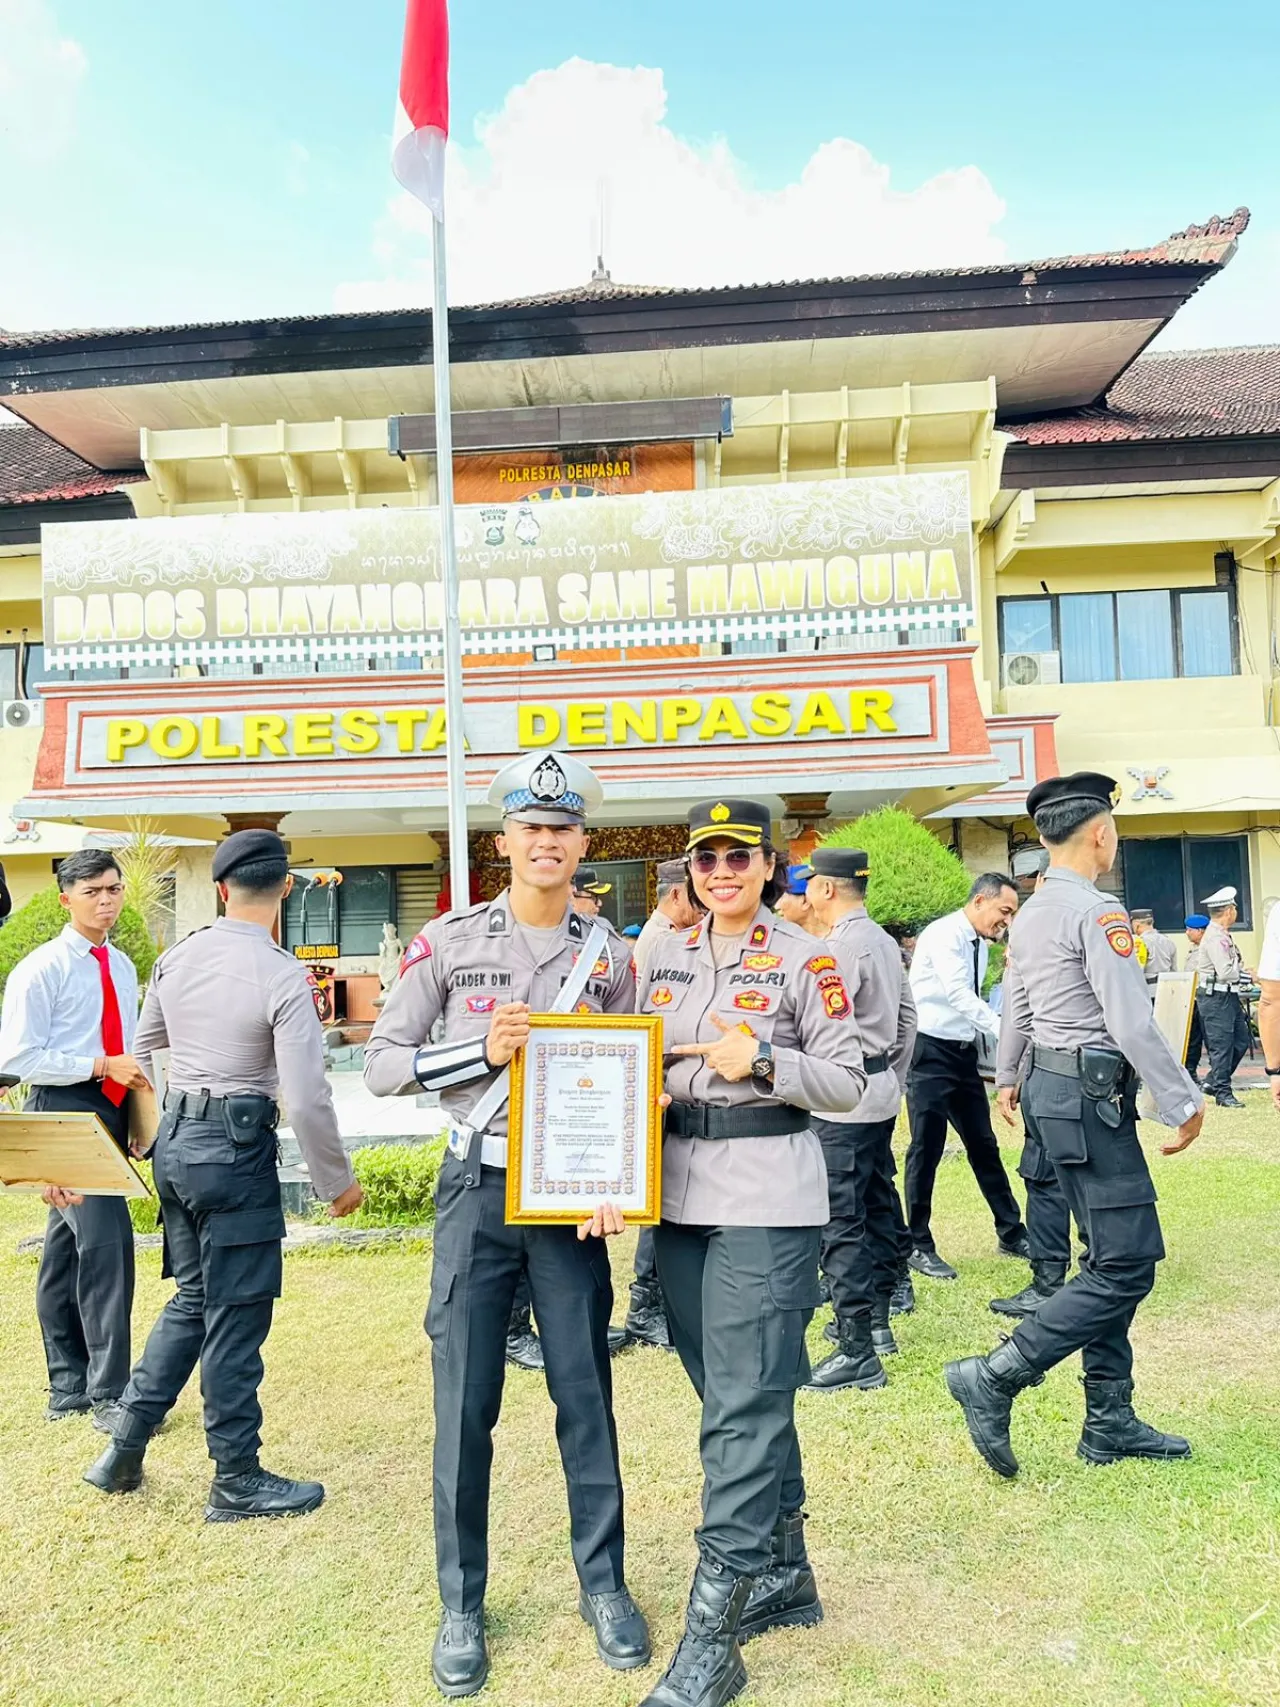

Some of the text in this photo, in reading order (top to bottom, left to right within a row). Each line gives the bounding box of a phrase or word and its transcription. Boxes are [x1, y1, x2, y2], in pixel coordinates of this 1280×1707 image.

[500, 461, 631, 483] POLRESTA DENPASAR
[54, 589, 206, 644] DADOS
[557, 568, 676, 624] SANE
[686, 549, 962, 615] MAWIGUNA
[106, 689, 898, 762] POLRESTA DENPASAR
[454, 972, 511, 988] KADEK DWI
[729, 972, 786, 987] POLRI
